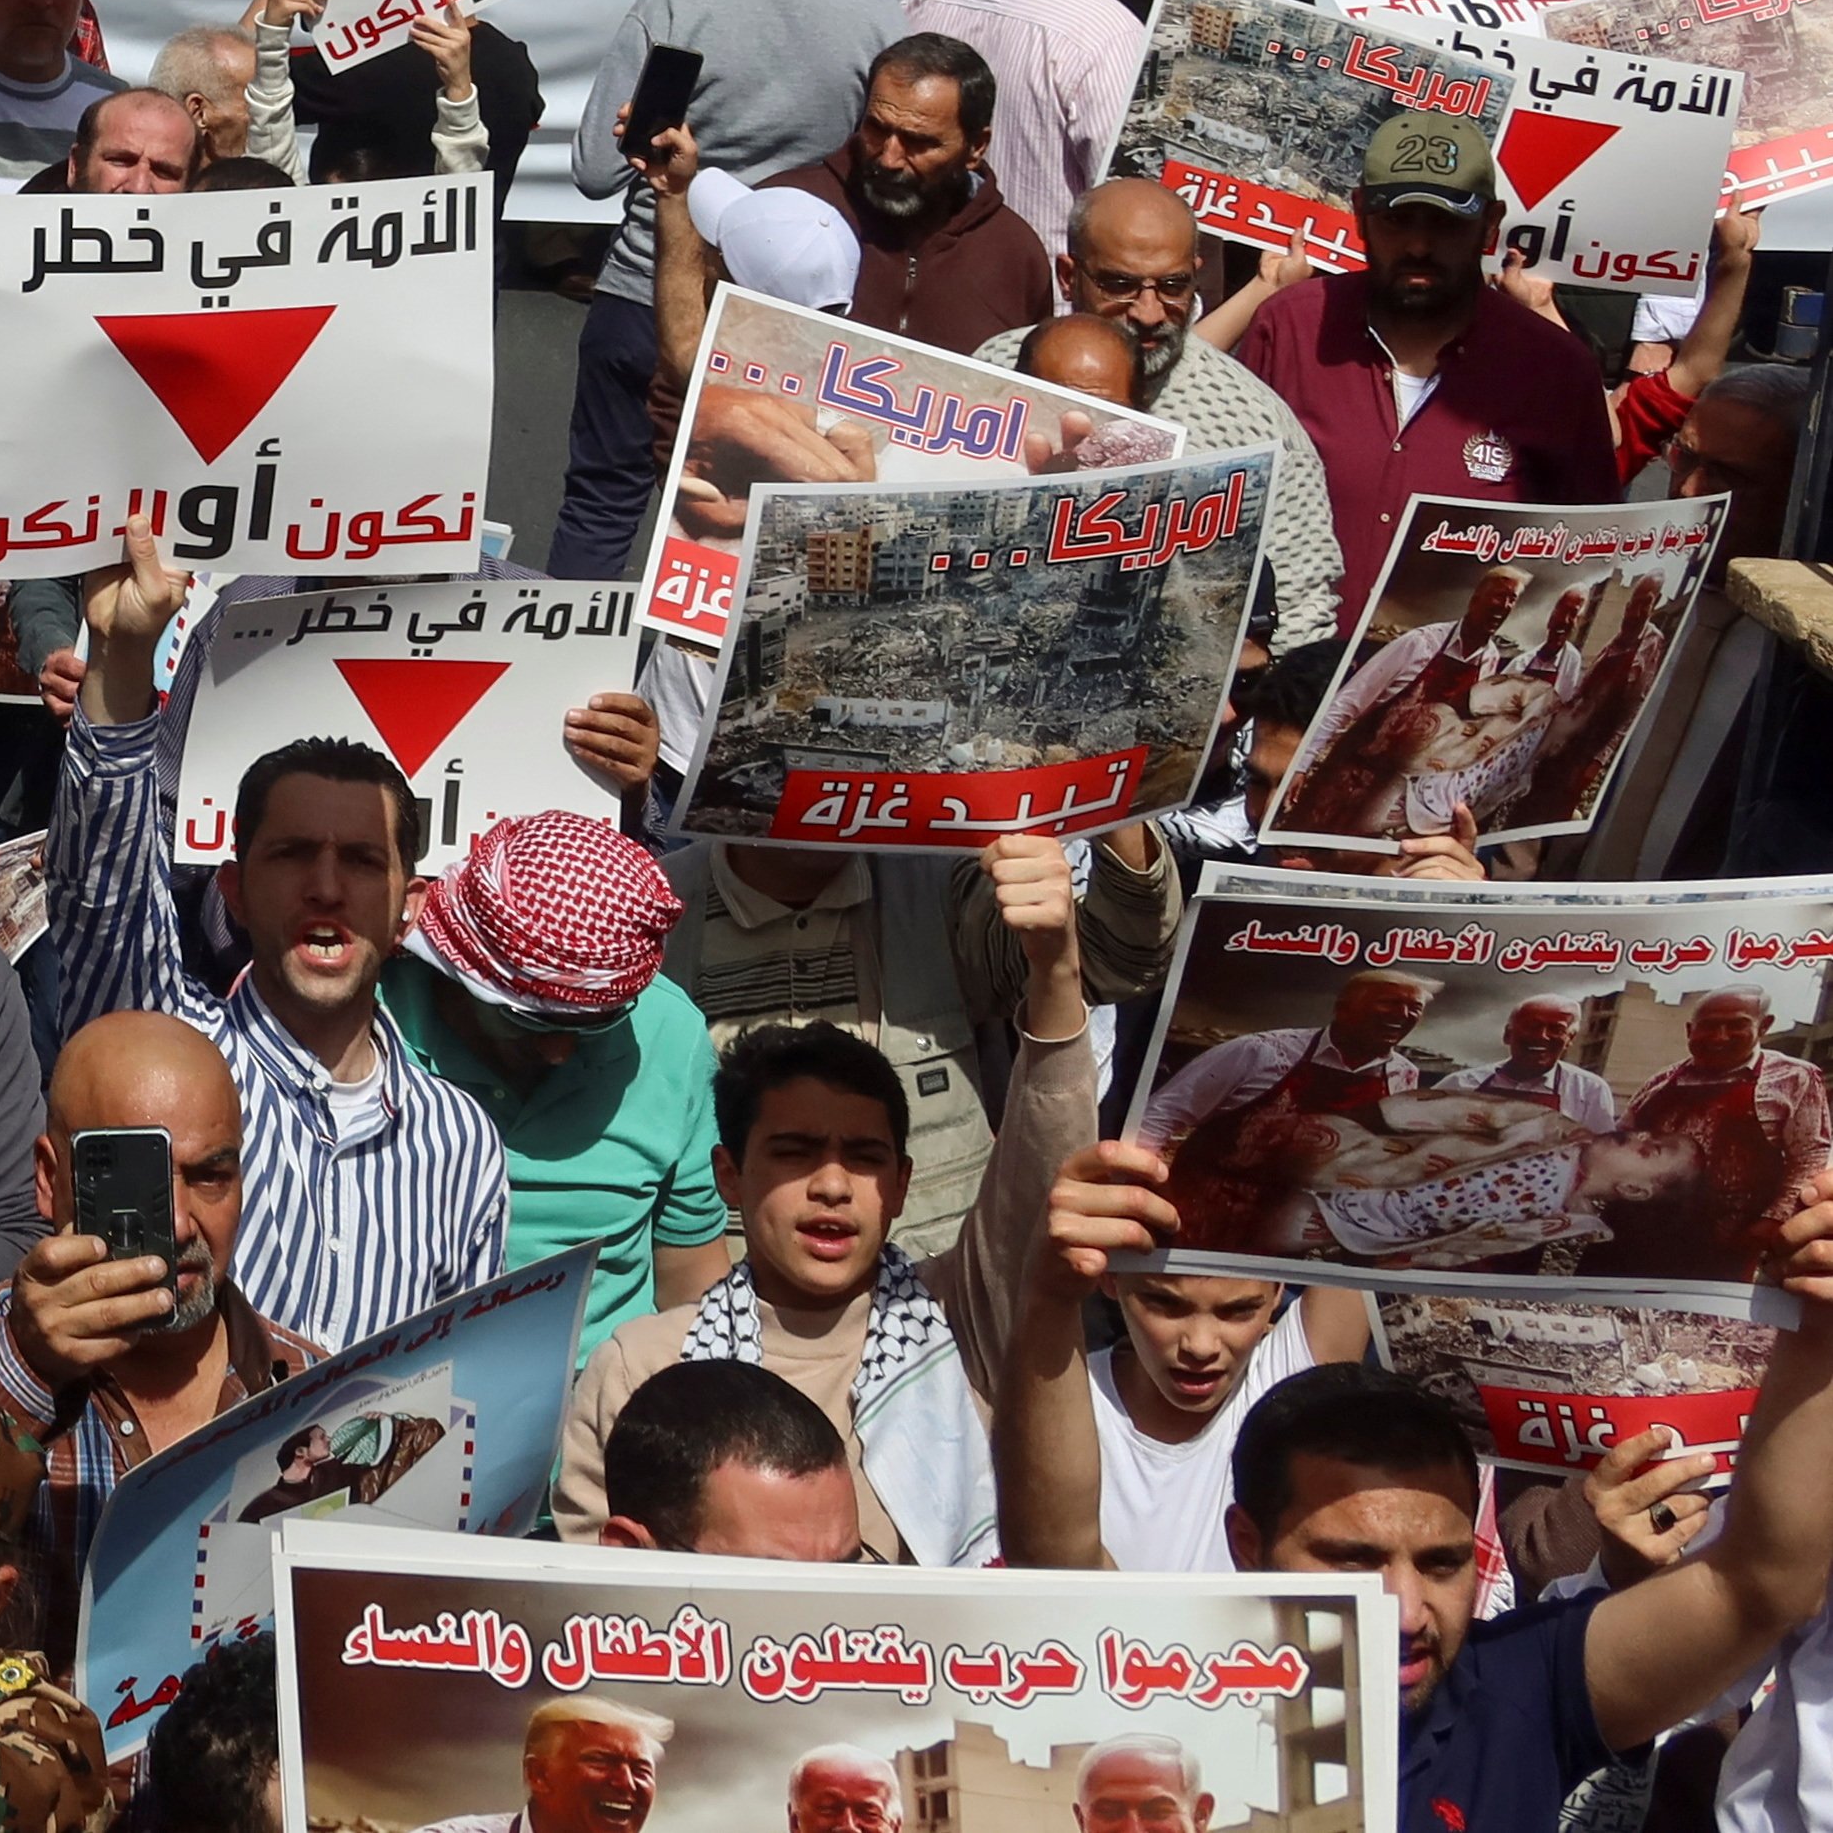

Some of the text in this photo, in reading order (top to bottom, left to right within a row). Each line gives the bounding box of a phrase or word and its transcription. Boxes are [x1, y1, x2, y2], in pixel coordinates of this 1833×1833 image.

[1528, 54, 1732, 117] الأمة في
[1390, 135, 1458, 176] 23
[1184, 174, 1241, 228] غزة
[22, 189, 479, 308] الأمة في خطر
[817, 341, 1031, 461] امريكا
[1467, 462, 1508, 478] LEGION
[1045, 470, 1247, 574] امريكا
[800, 757, 1132, 838] تبيد غزة
[1223, 921, 1361, 966] والنساء
[1361, 923, 1495, 968] الأطفال
[1499, 929, 1624, 973] يقتلون
[1627, 932, 1718, 972] حرب
[1514, 1397, 1616, 1465] غزة
[341, 1602, 1313, 1714] مجرموا حرب يقتلون الأطفال والنساء
